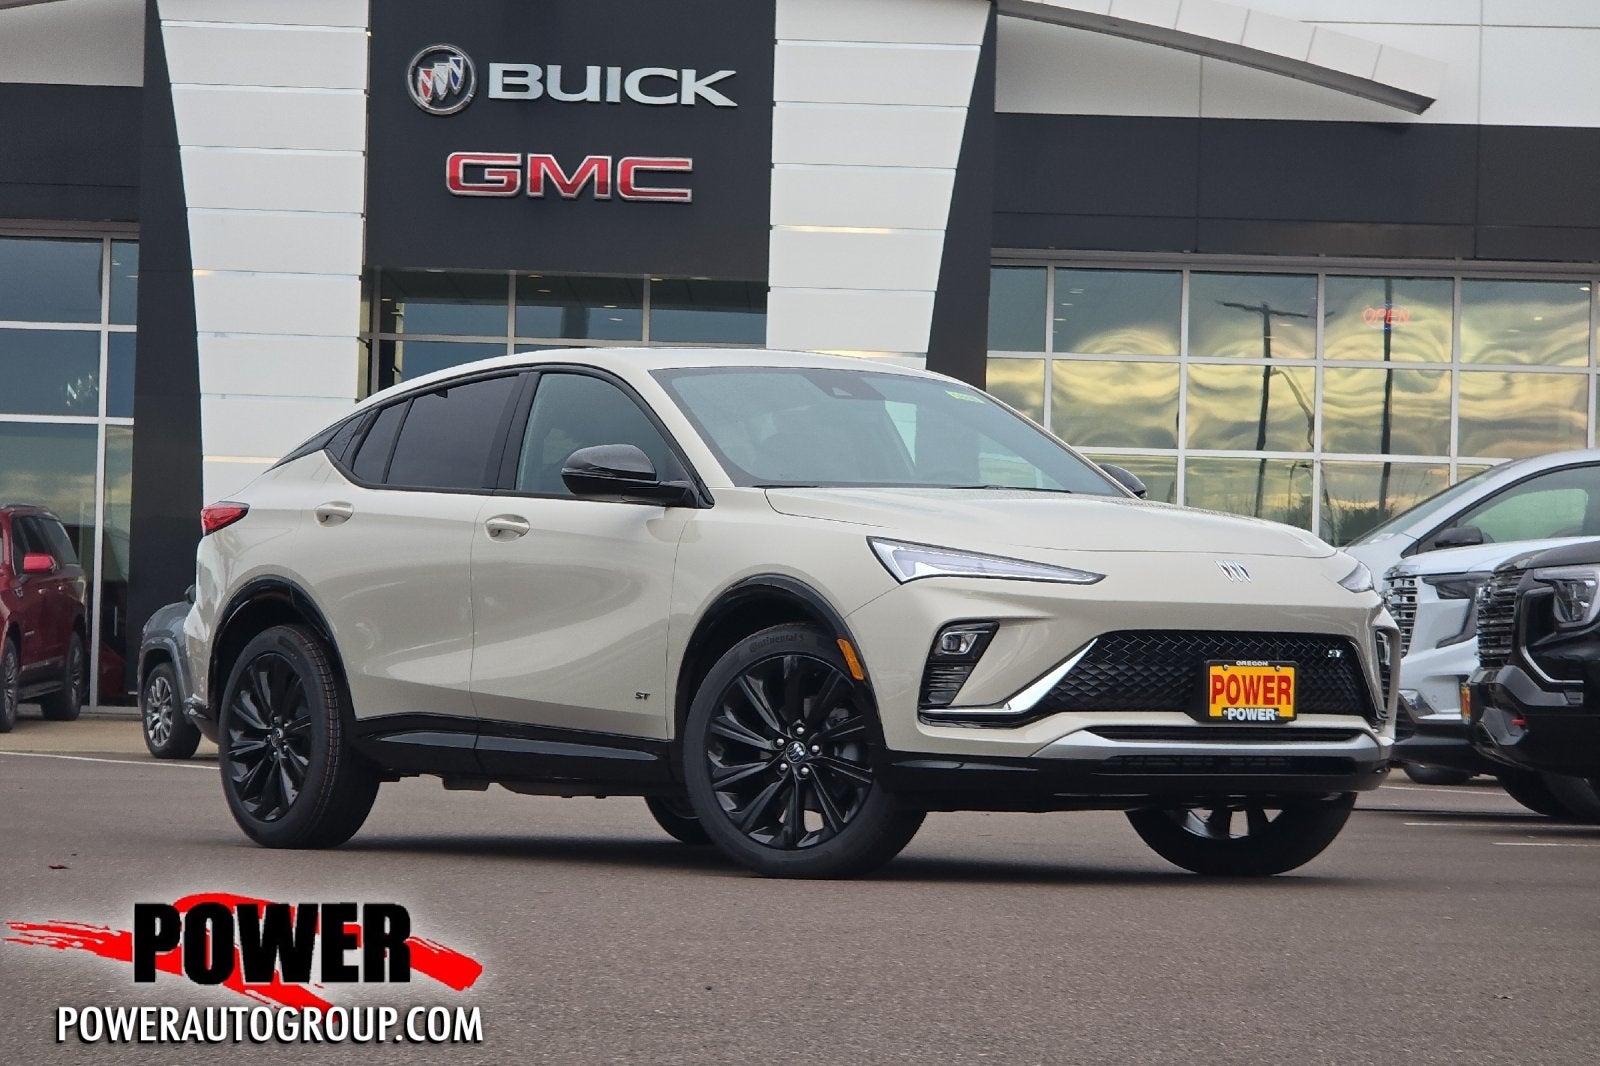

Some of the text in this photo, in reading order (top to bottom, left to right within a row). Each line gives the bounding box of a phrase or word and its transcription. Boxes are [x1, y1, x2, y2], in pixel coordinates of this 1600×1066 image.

[488, 62, 738, 107] BUICK
[446, 152, 693, 203] GMC
[1362, 307, 1409, 325] OPEN
[634, 691, 651, 700] ST
[1211, 674, 1292, 705] POWER
[1227, 708, 1276, 721] POWER
